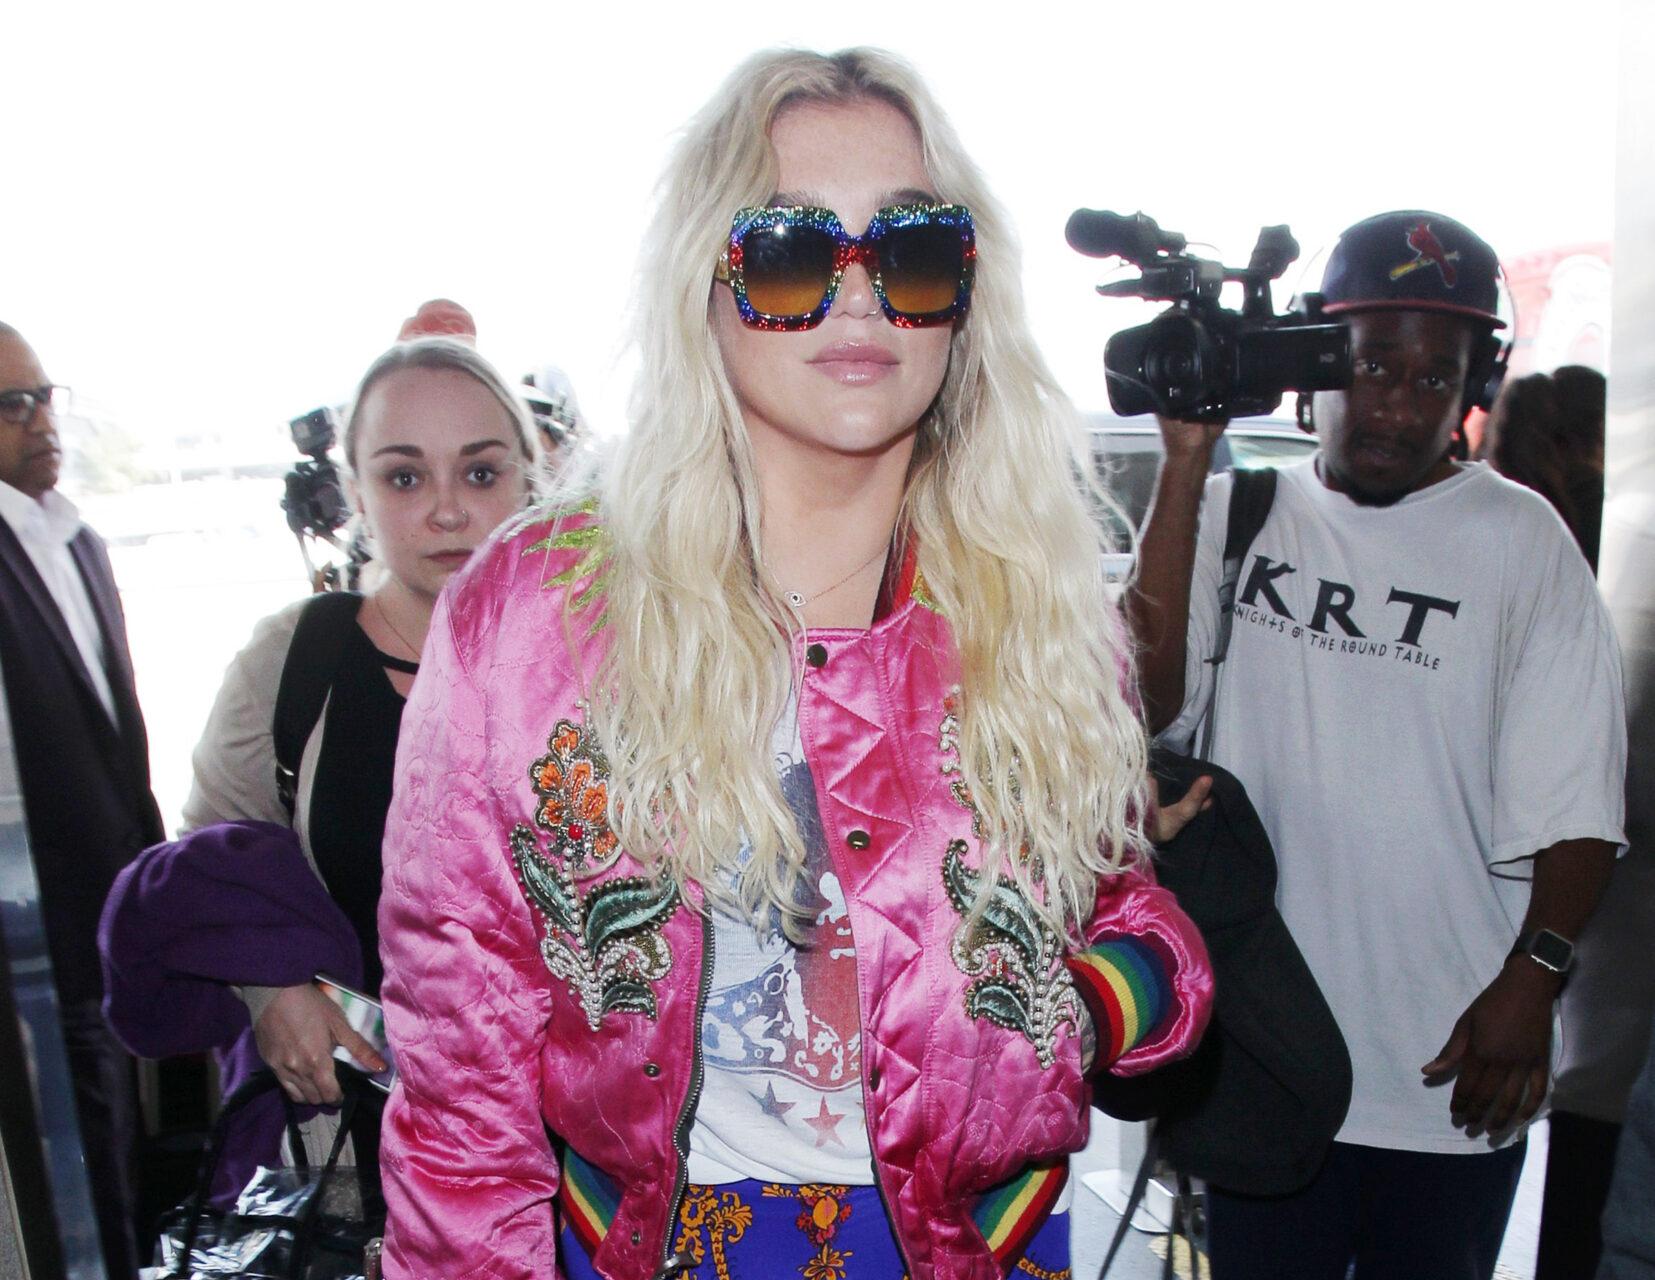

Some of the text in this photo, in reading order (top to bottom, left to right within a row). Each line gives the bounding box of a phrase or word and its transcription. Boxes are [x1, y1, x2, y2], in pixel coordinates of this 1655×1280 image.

[1239, 554, 1461, 648] KRT
[1310, 633, 1335, 651] THE
[1340, 641, 1387, 657] ROUND
[1395, 646, 1441, 670] TABLE
